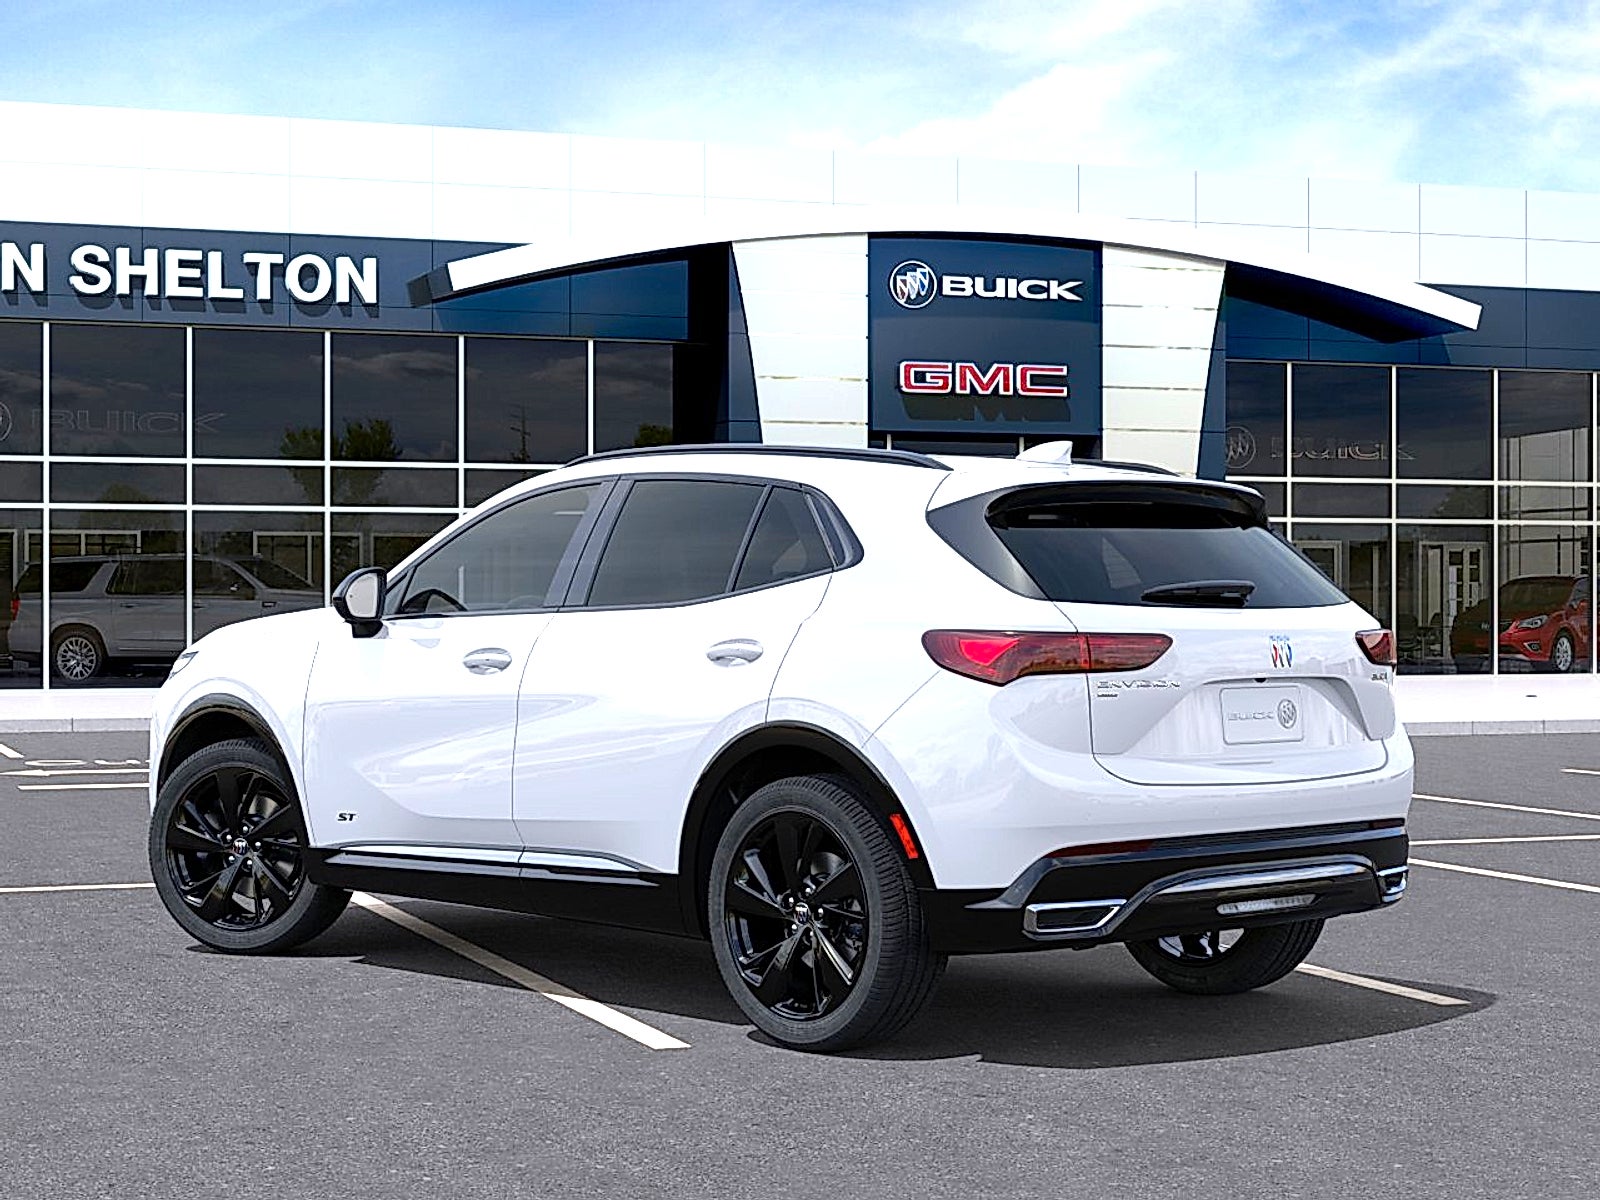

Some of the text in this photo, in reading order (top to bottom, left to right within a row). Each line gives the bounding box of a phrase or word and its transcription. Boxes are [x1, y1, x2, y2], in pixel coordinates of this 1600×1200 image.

[69, 244, 378, 304] SHELTON
[941, 275, 1084, 302] BUICK
[900, 361, 1068, 397] GMC
[337, 812, 357, 822] ST
